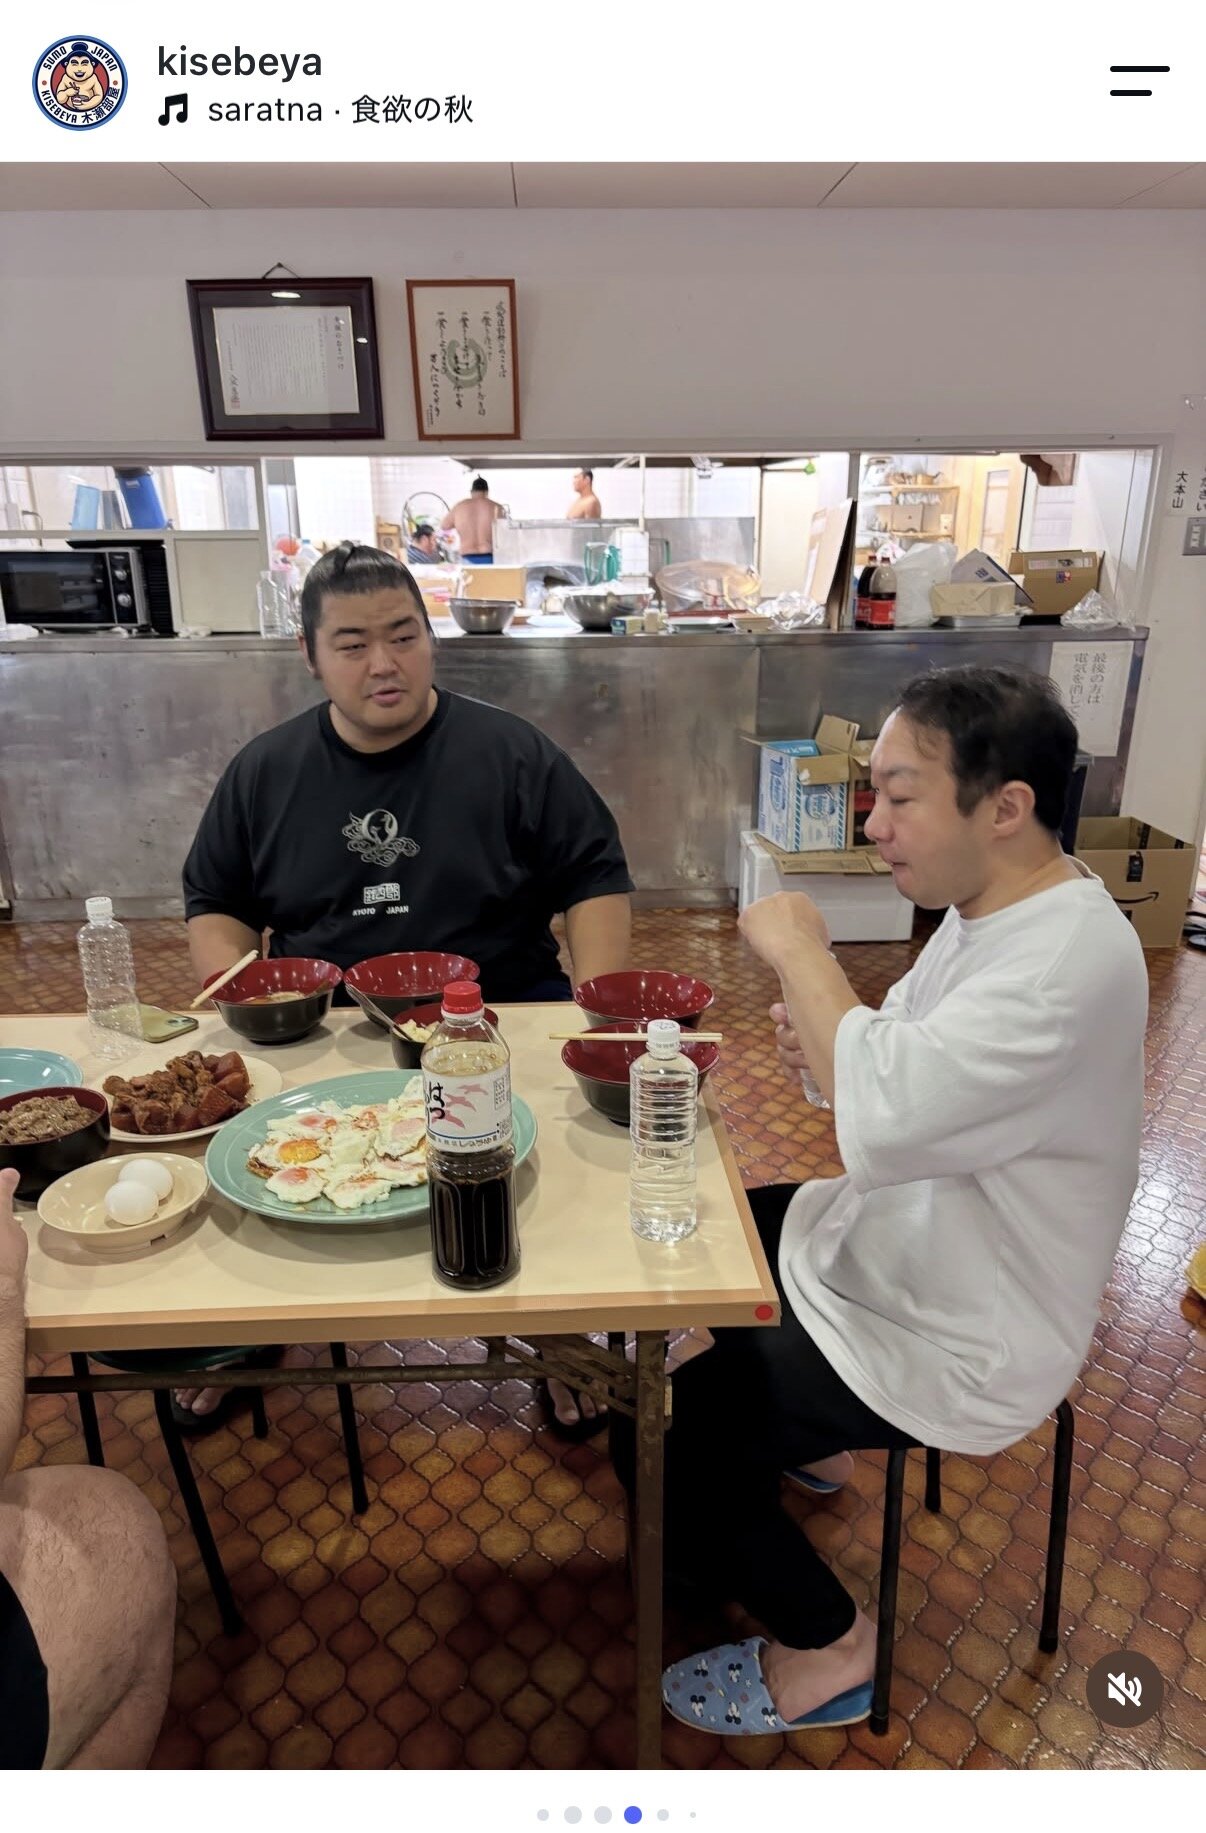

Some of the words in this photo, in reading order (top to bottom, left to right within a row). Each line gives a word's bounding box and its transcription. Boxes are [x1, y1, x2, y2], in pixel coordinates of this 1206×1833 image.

[1172, 471, 1188, 509] 大本山
[386, 905, 409, 915] JAPAN
